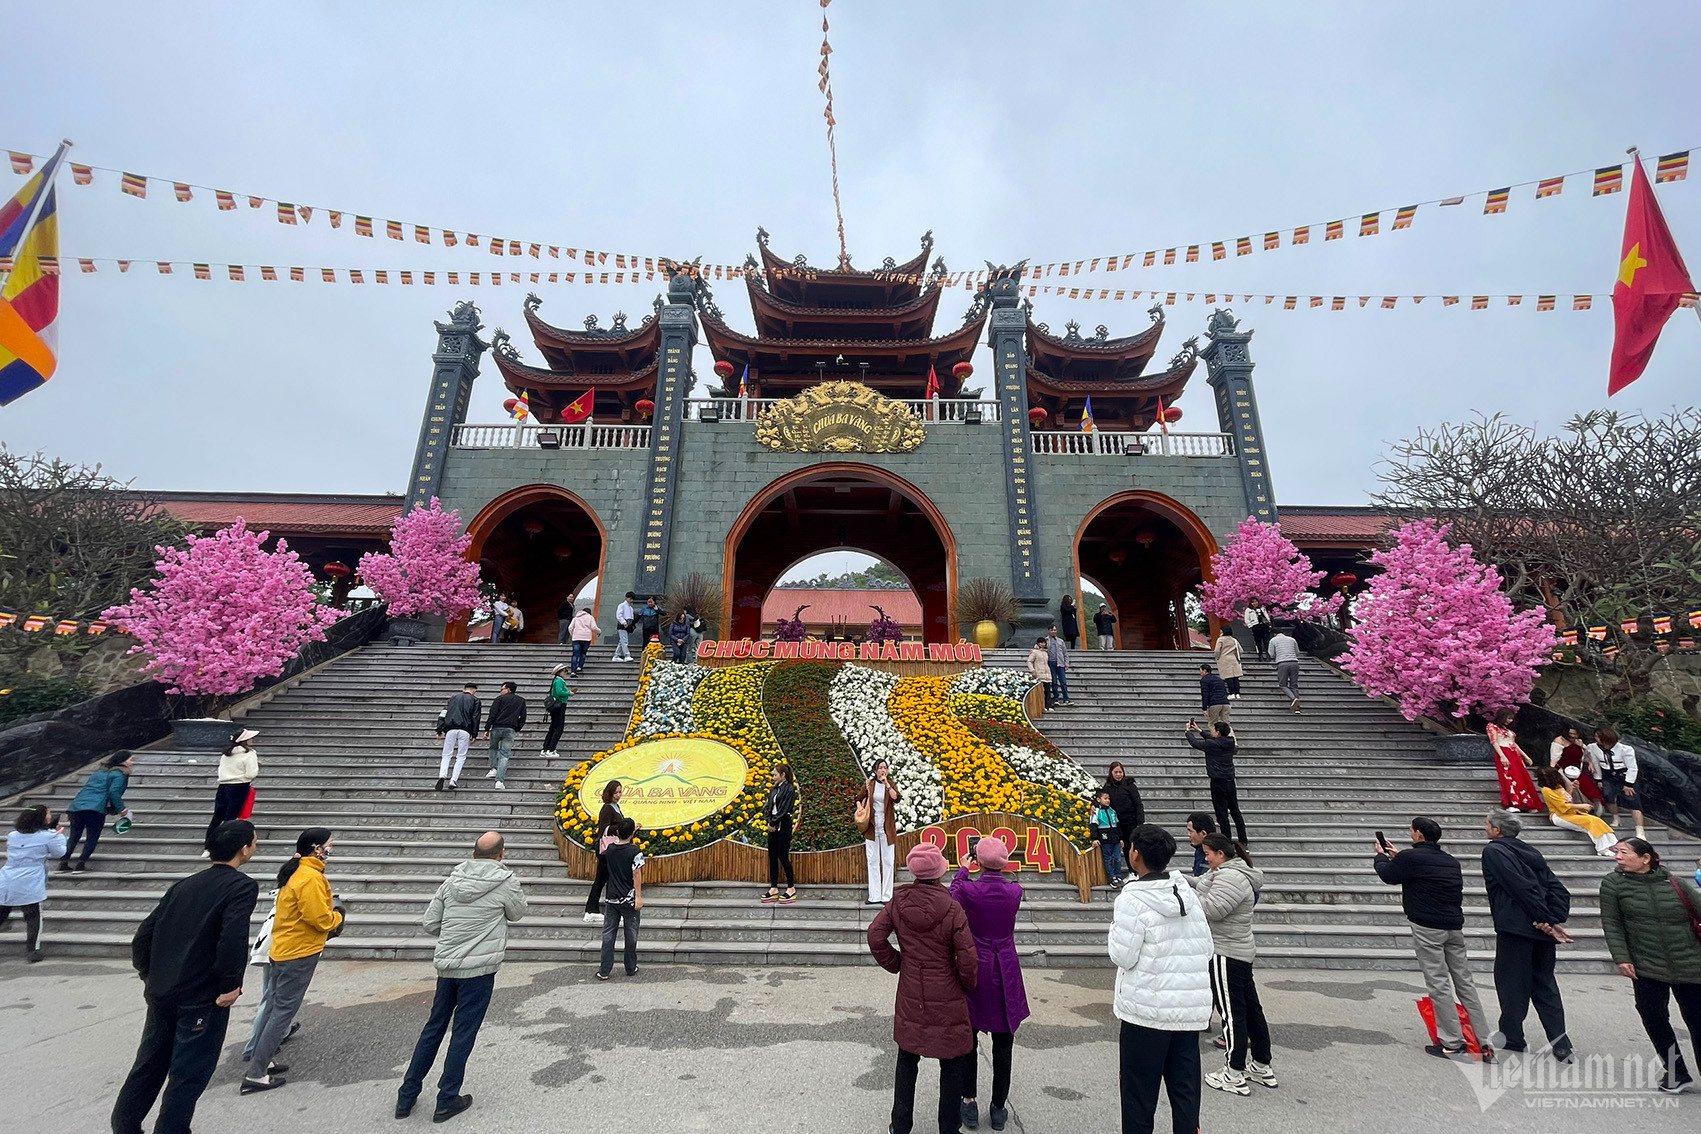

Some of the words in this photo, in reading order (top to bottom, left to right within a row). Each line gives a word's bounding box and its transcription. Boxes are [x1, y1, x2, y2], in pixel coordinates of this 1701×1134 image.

[813, 413, 835, 434] CHÙA
[836, 413, 849, 424] BA
[849, 415, 872, 434] VÀNG
[697, 637, 770, 658] CHÚC
[774, 636, 856, 660] MỪNG
[860, 639, 926, 661] NĂM
[928, 638, 982, 662] MỚI
[594, 785, 644, 797] CÙA
[647, 787, 674, 797] BA
[678, 785, 728, 797] VÀNG
